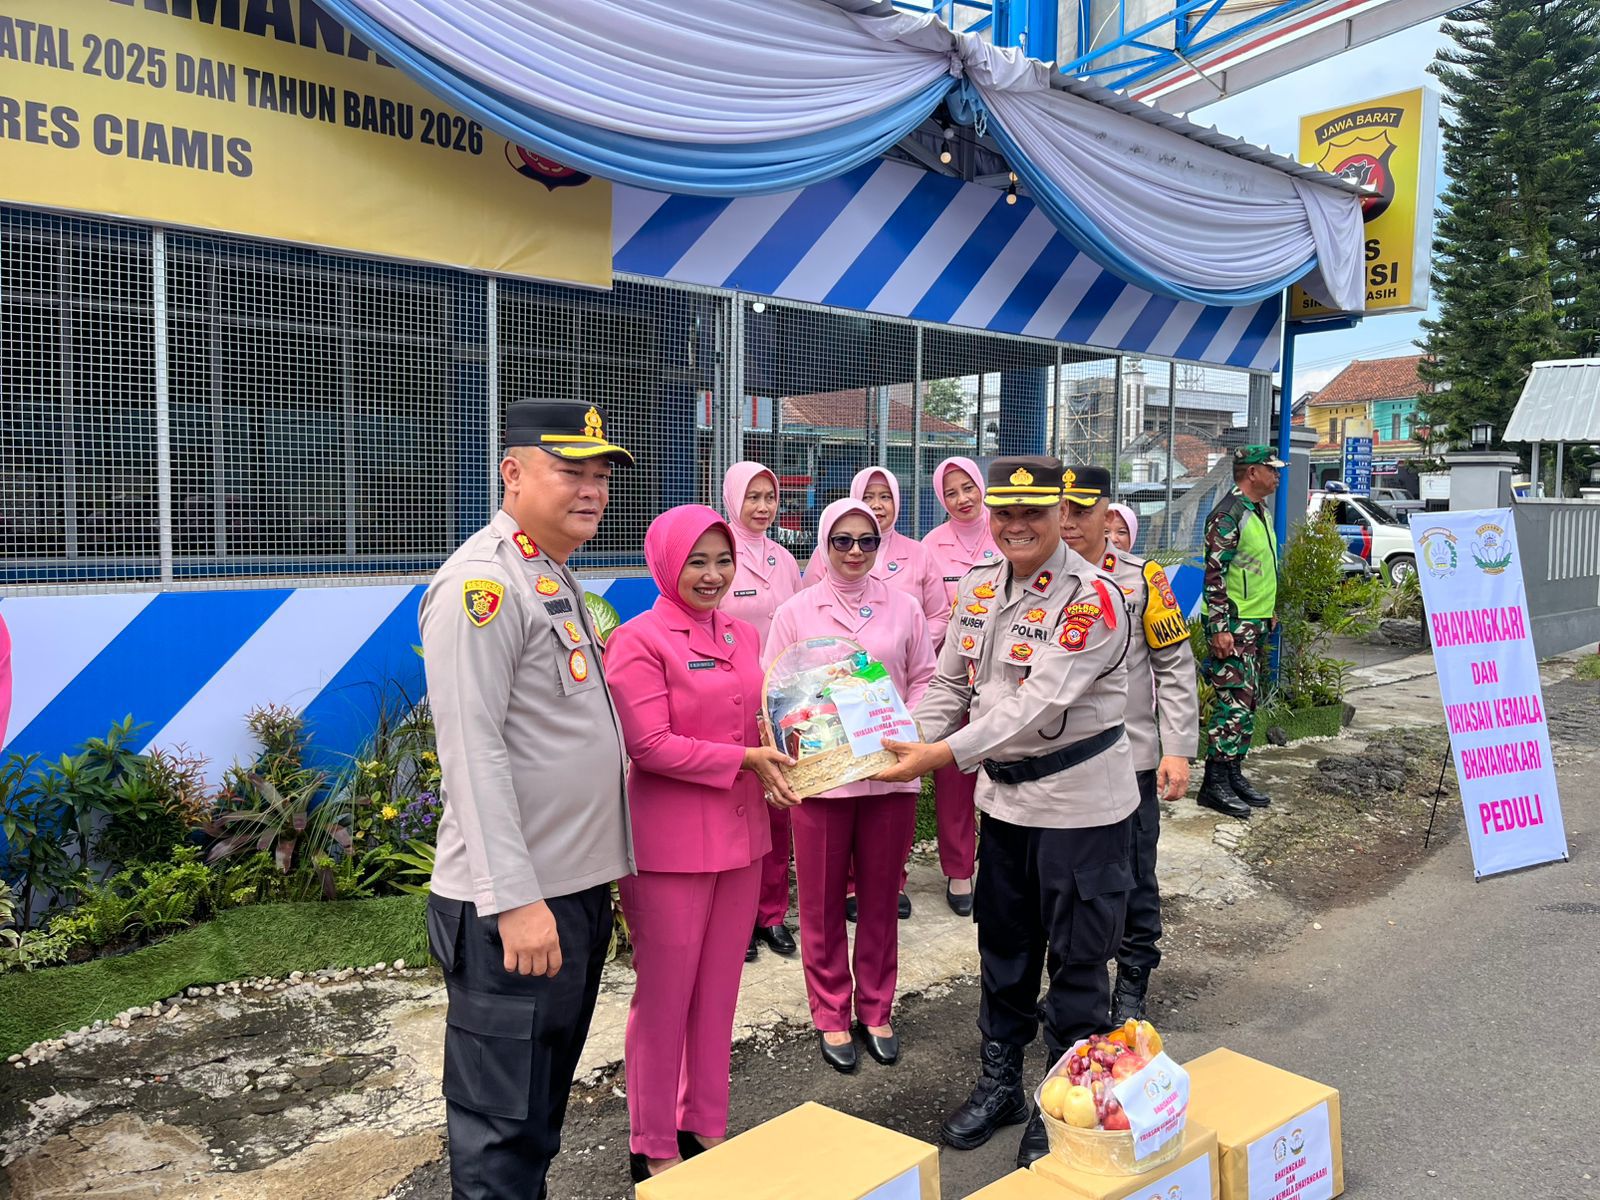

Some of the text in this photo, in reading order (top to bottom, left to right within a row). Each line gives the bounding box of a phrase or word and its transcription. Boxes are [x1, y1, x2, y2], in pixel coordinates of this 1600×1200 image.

[0, 16, 483, 155] ATAL 2025 DAN TAHUN BARU 2026
[0, 96, 253, 177] RES CIAMIS
[1322, 112, 1397, 139] JAWA BARAT
[960, 616, 985, 629] HUSEN
[1011, 624, 1047, 641] POLRI
[1431, 606, 1526, 647] BHAYANGKARI
[1471, 660, 1499, 685] DAN
[1446, 695, 1543, 734] YAYASAN KEMALA
[1461, 740, 1542, 780] BHAYANGKARI
[1479, 794, 1544, 834] PEDULI
[1275, 1157, 1307, 1182] BHAYANGKARI
[1286, 1174, 1296, 1186] DAN
[1295, 1167, 1328, 1192] BHAYANGKARI
